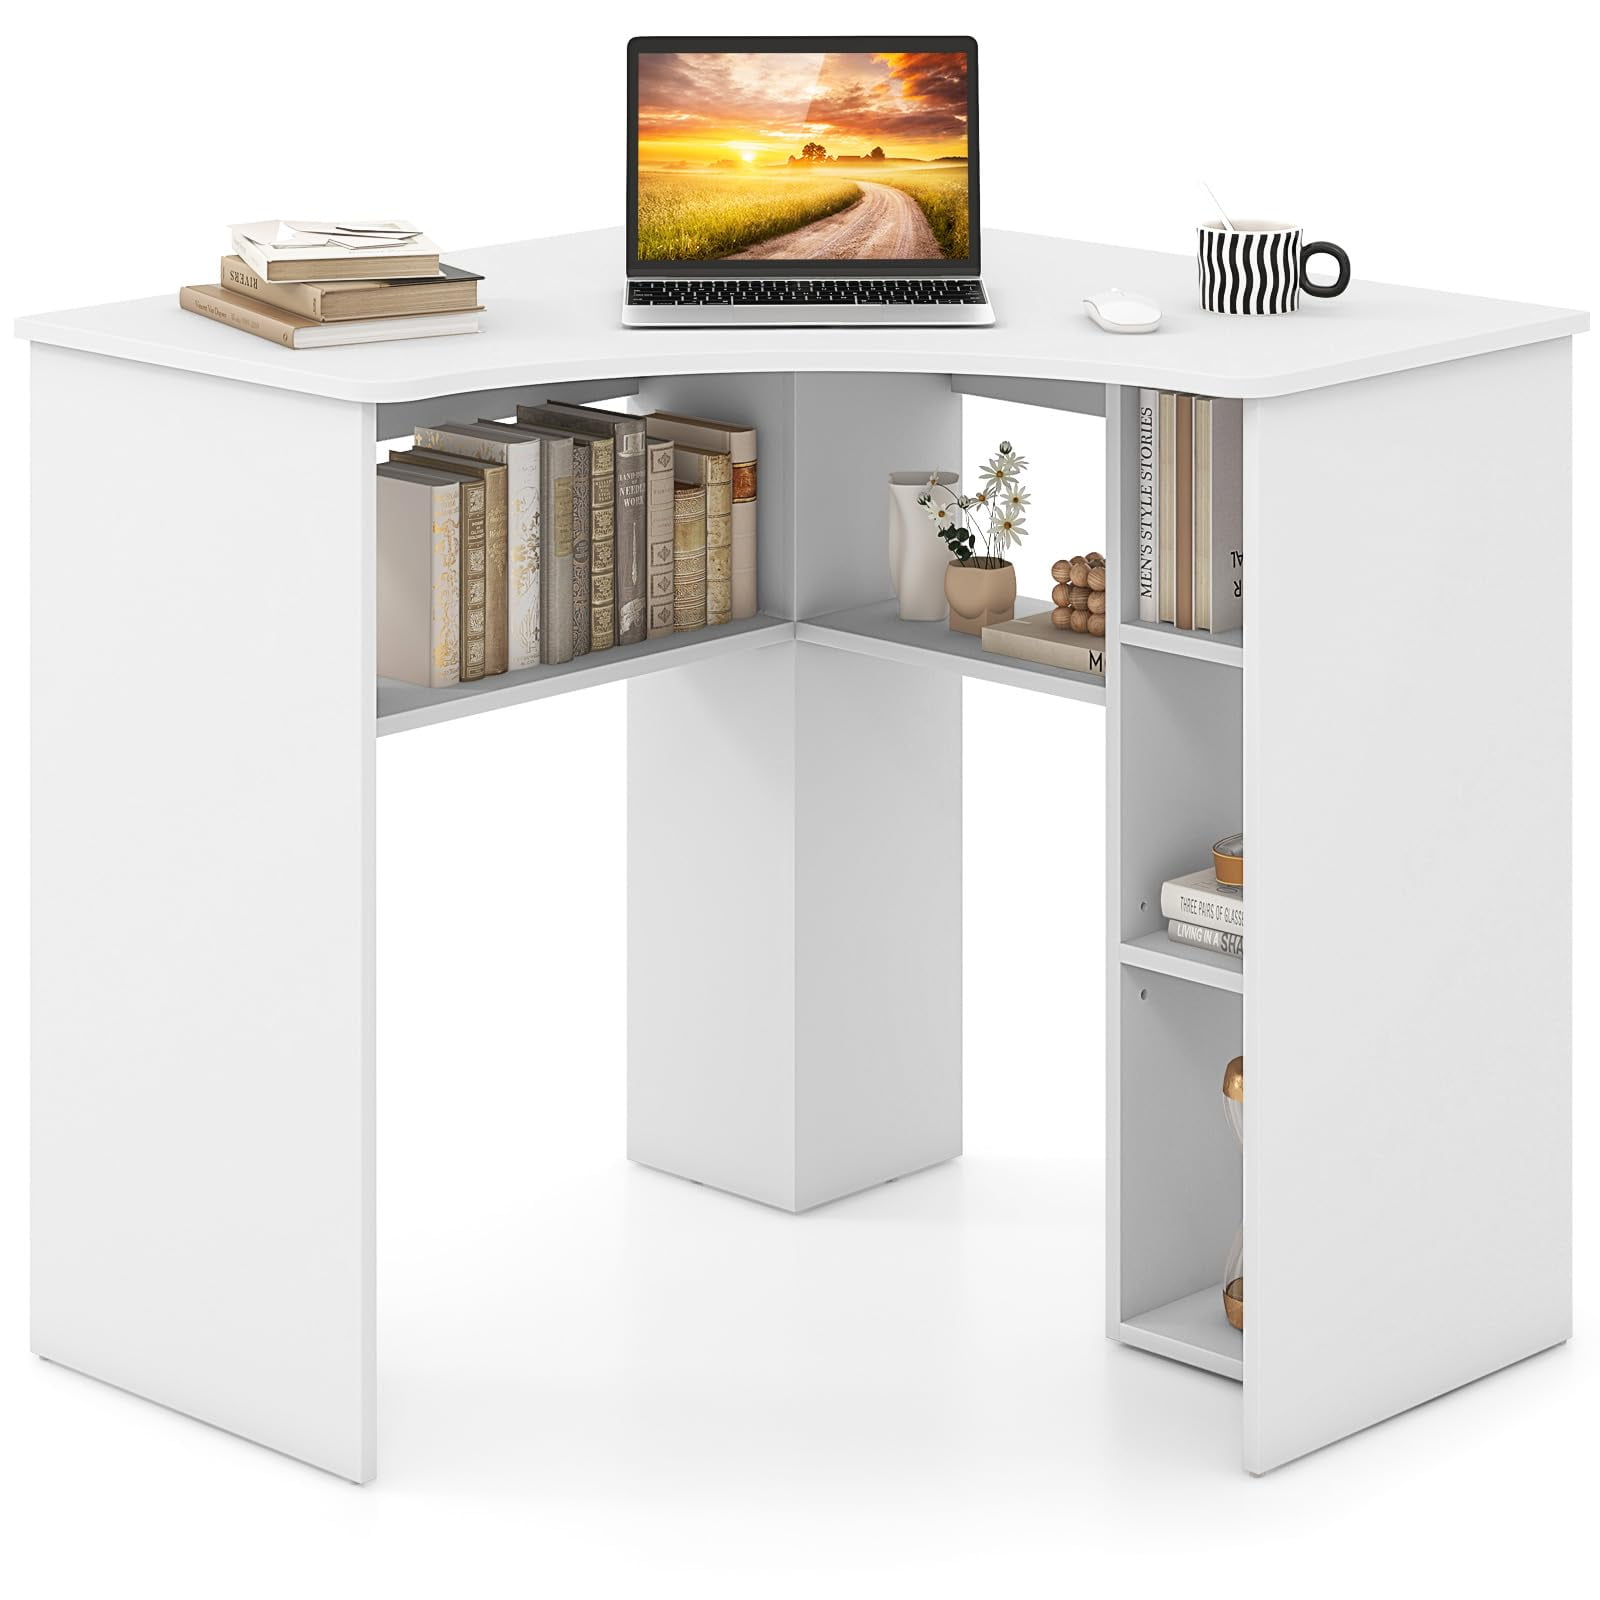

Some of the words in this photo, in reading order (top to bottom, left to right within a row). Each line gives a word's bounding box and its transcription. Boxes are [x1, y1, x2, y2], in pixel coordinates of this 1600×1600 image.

[229, 270, 258, 289] RIVERS
[1140, 406, 1153, 482] STORIES
[1140, 485, 1153, 541] STYLE
[1140, 543, 1153, 599] MEN'S
[1180, 896, 1198, 915] THREE
[1199, 900, 1215, 920] PAIRS
[1216, 904, 1223, 921] OF
[1177, 923, 1203, 943] LIVING
[1203, 929, 1212, 945] IN
[1212, 932, 1220, 947] A
